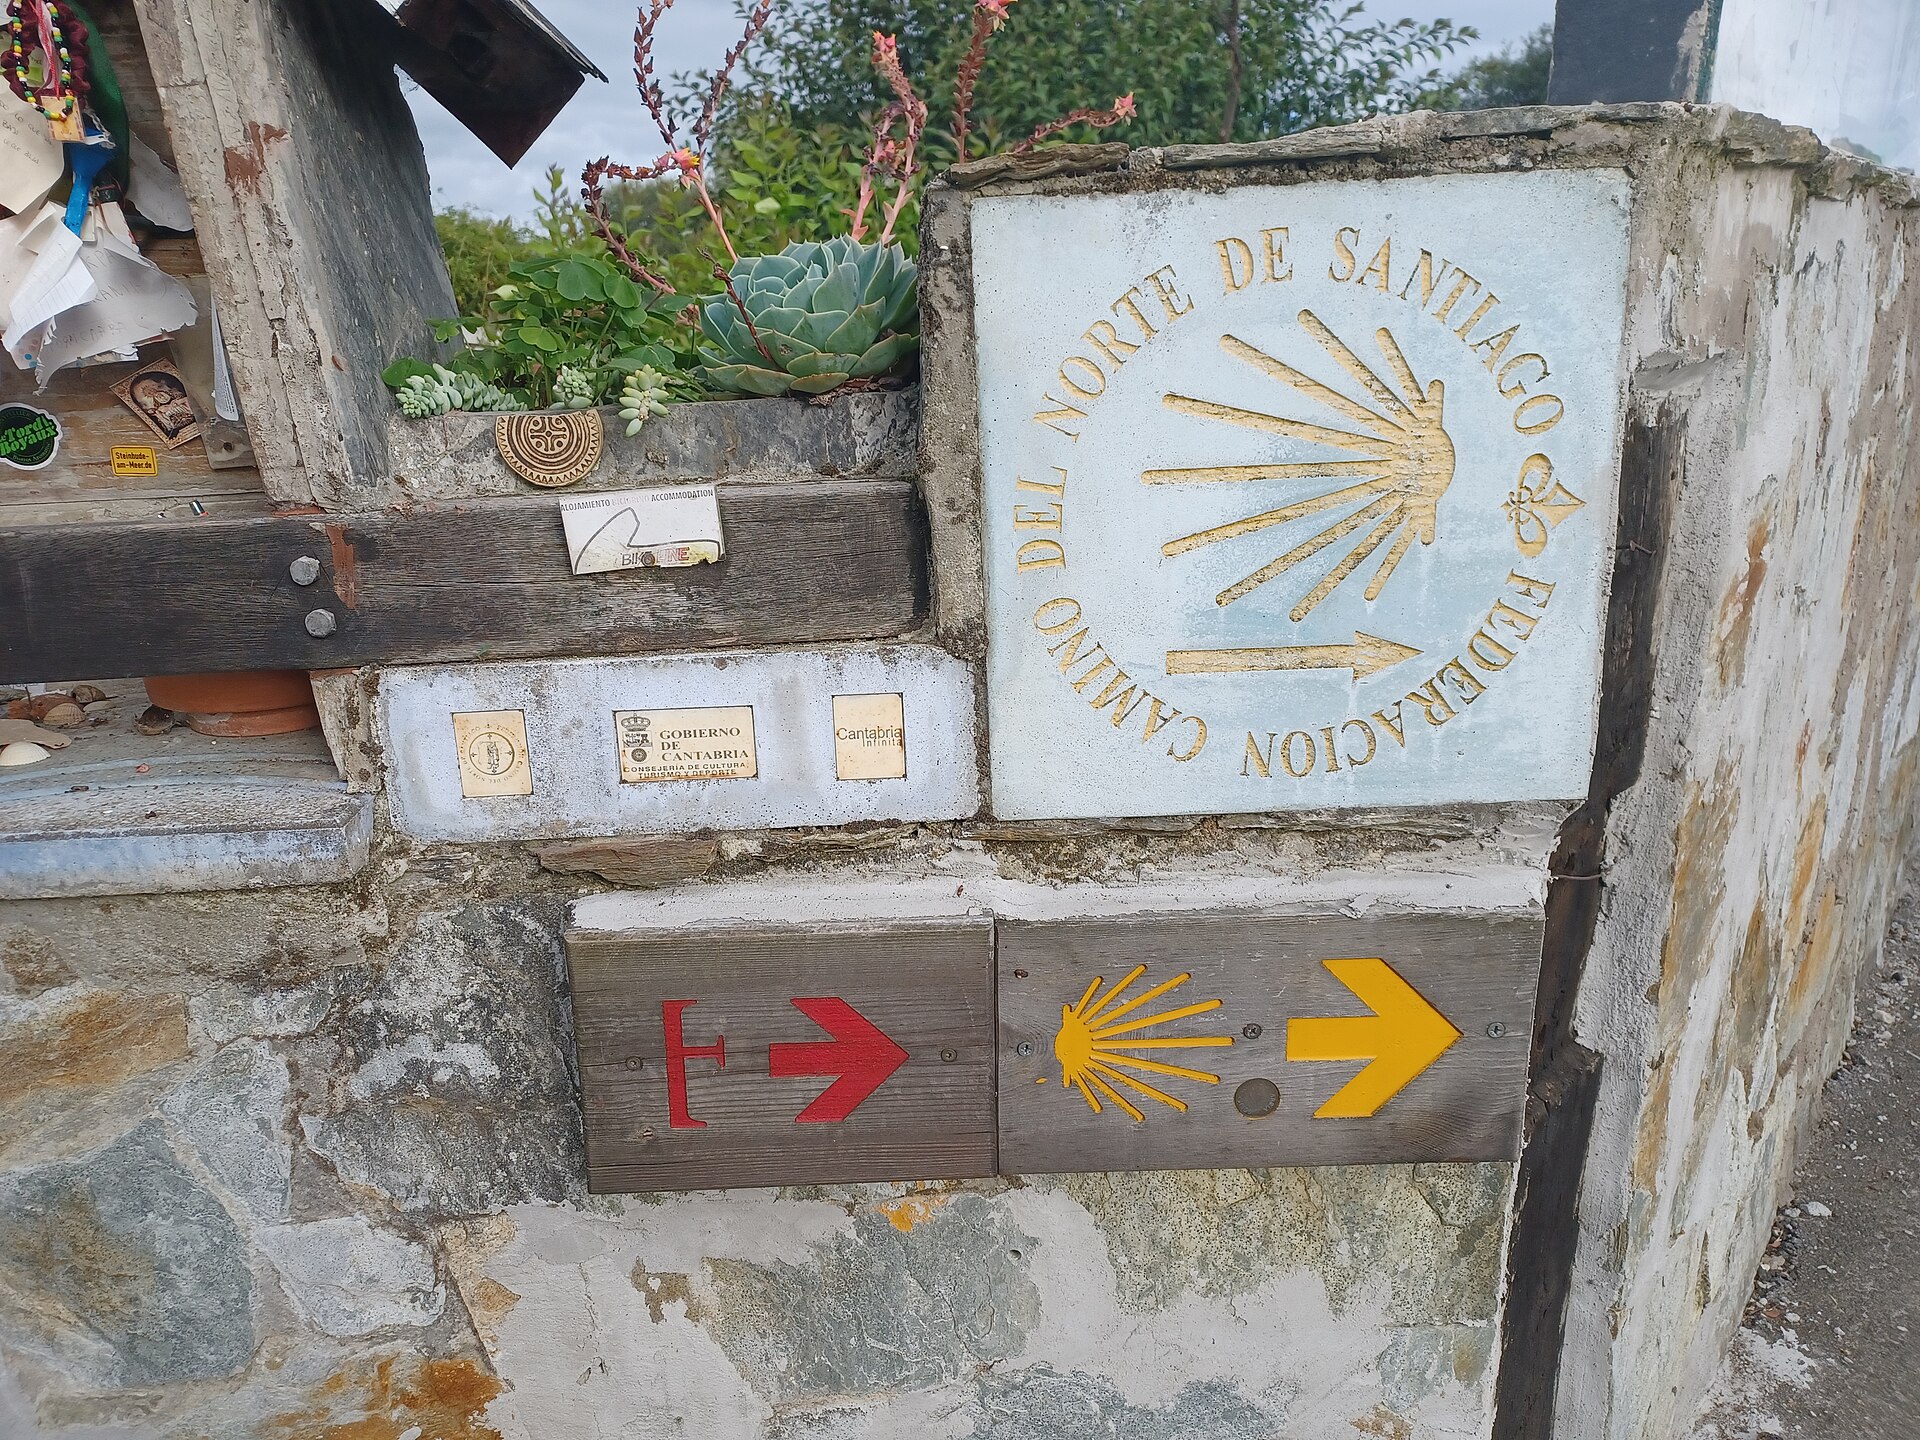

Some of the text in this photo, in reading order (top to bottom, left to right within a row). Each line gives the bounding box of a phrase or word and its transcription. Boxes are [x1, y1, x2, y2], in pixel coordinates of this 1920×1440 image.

[560, 500, 611, 512] ALOJAMIENTO
[651, 489, 714, 502] ACCOMMODATION
[1015, 227, 1564, 777] FEDERACION CAMINO DEL NORTE DE SANTIAGO
[659, 727, 741, 740] GOBIERNO
[836, 725, 903, 740] Cantabria
[661, 741, 681, 751] DE
[661, 750, 749, 762] CANTABRIA
[638, 770, 681, 779] TURISMO
[693, 768, 737, 777] DEPORTE
